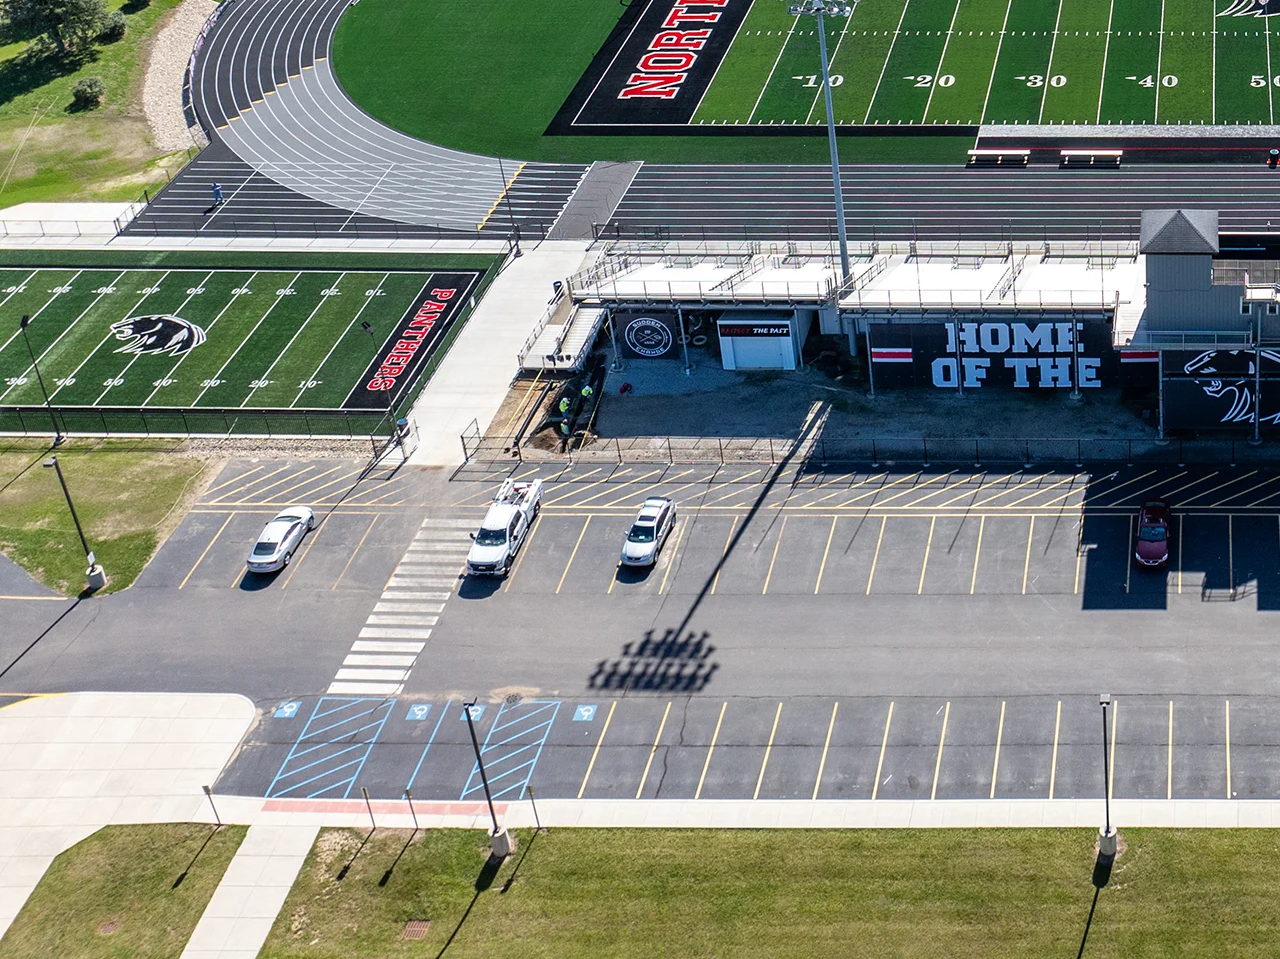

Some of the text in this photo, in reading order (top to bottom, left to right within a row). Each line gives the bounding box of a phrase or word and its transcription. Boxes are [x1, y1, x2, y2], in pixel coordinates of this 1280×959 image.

[801, 74, 843, 88] 10
[914, 74, 955, 88] 20
[1026, 74, 1067, 88] 30
[1138, 74, 1178, 88] 40
[366, 288, 457, 391] PANTHERS
[945, 323, 1084, 353] HOME
[931, 357, 1102, 388] OF THE
[103, 378, 125, 386] 50
[248, 379, 269, 388] 20
[298, 380, 317, 388] 10
